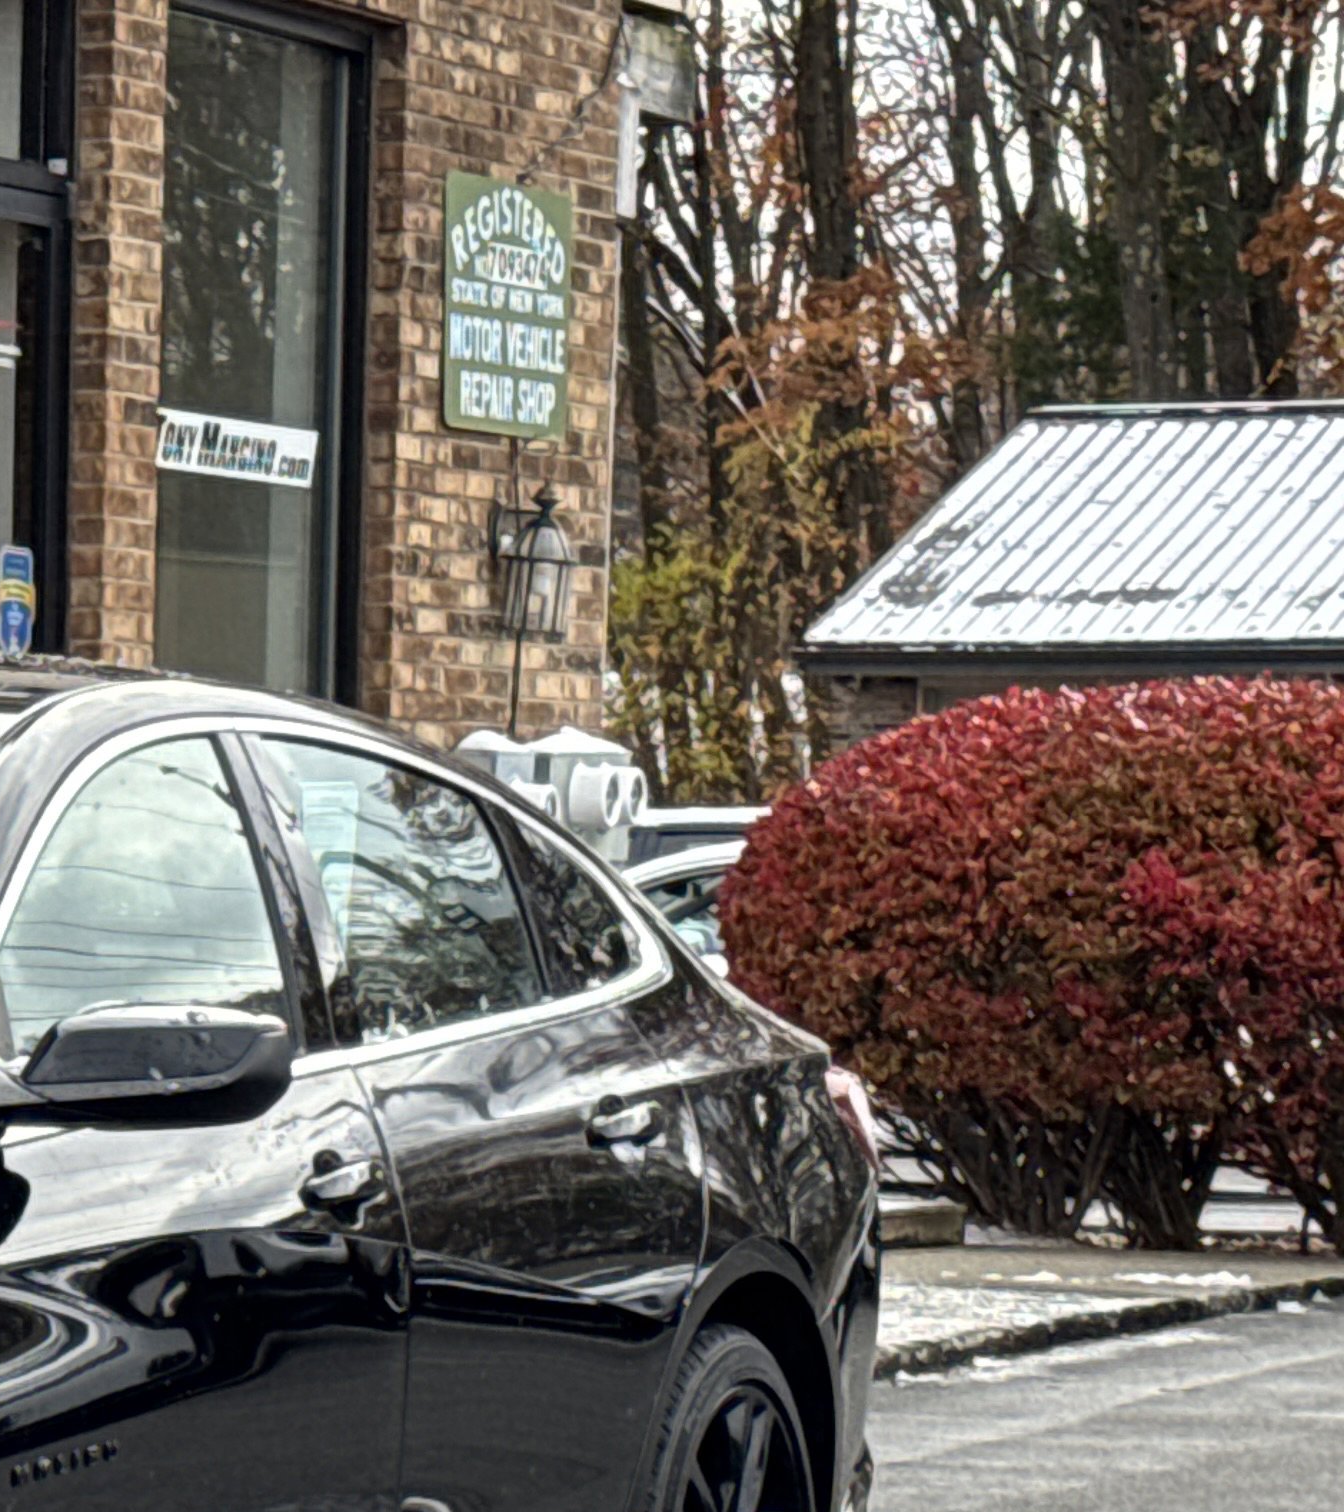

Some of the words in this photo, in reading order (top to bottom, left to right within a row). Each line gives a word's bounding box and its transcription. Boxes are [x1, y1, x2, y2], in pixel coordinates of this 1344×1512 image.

[451, 186, 565, 284] REGISTERED
[451, 277, 488, 308] STATE
[449, 312, 503, 365] MOTOR
[506, 320, 566, 374] VEHICLE
[459, 369, 514, 422] REPAIR
[517, 377, 556, 428] SHOP
